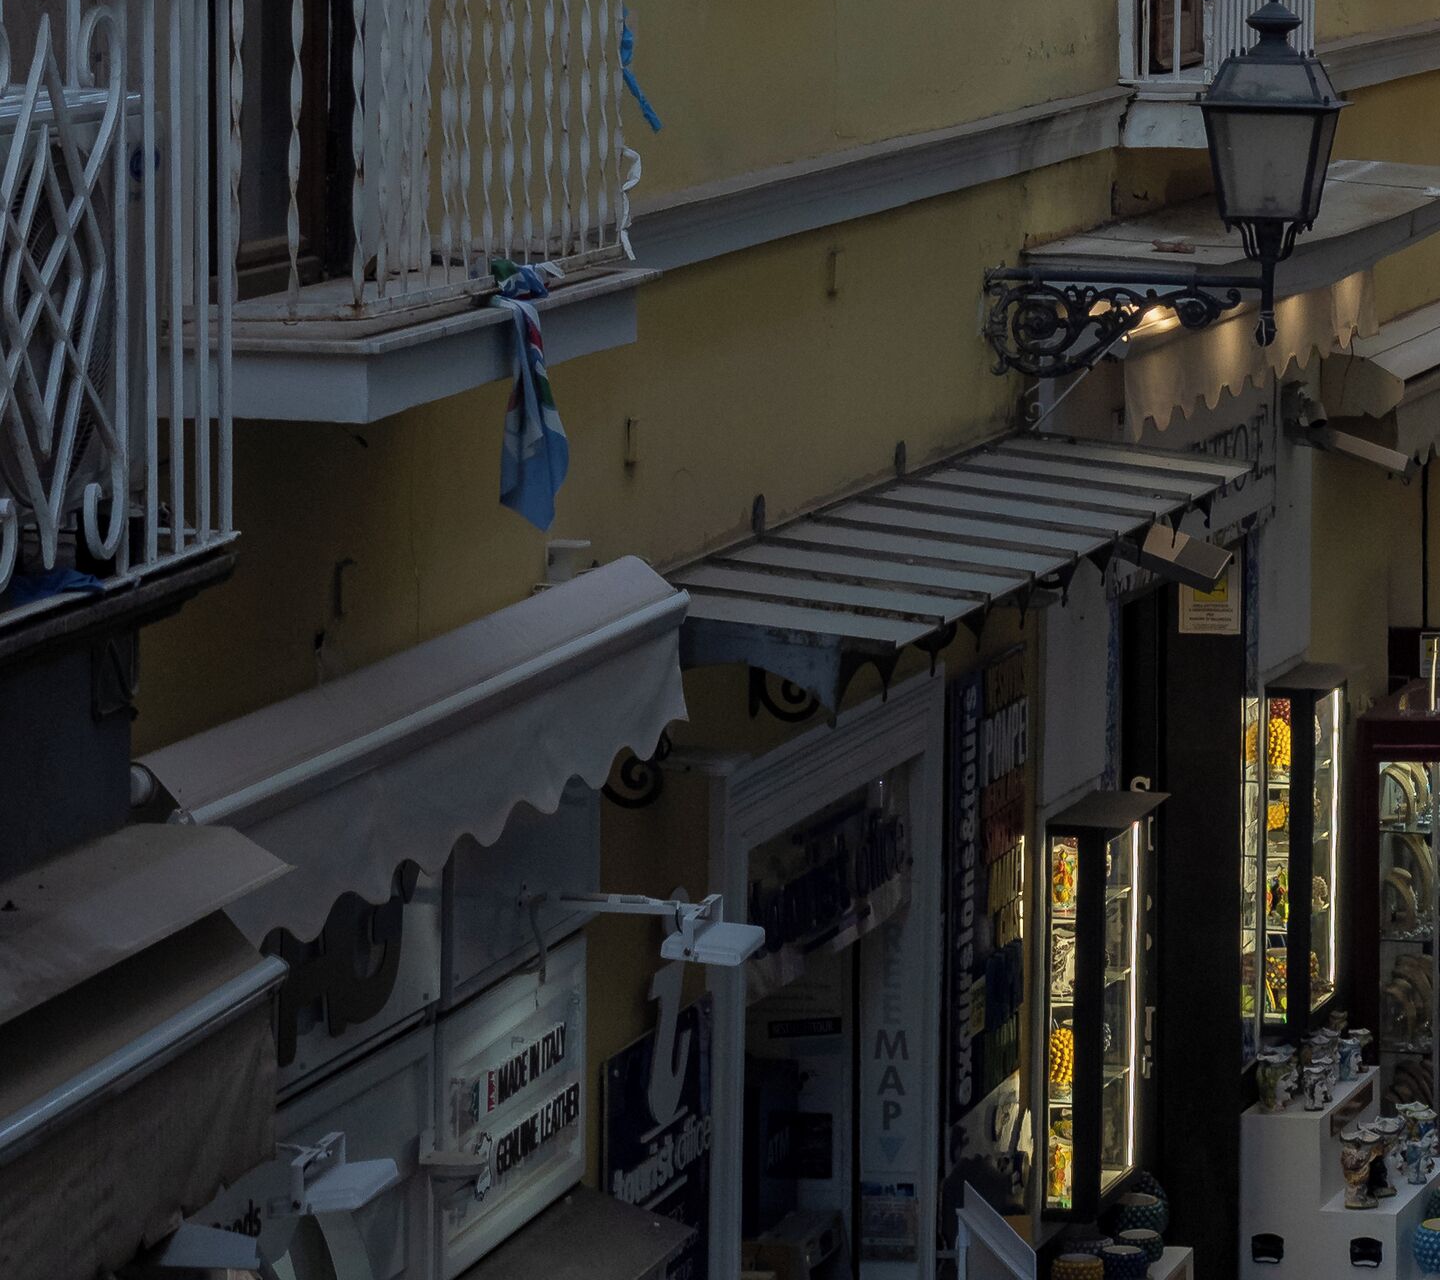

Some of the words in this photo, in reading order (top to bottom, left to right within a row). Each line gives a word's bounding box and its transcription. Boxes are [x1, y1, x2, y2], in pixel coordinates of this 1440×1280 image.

[984, 695, 1029, 787] POMPEI
[497, 1050, 528, 1105] MADE
[529, 1040, 540, 1083] IN
[541, 1022, 567, 1073] ITALY
[874, 1028, 909, 1131] MAP
[496, 1111, 540, 1176] GENUINE
[541, 1082, 580, 1144] LEATHER
